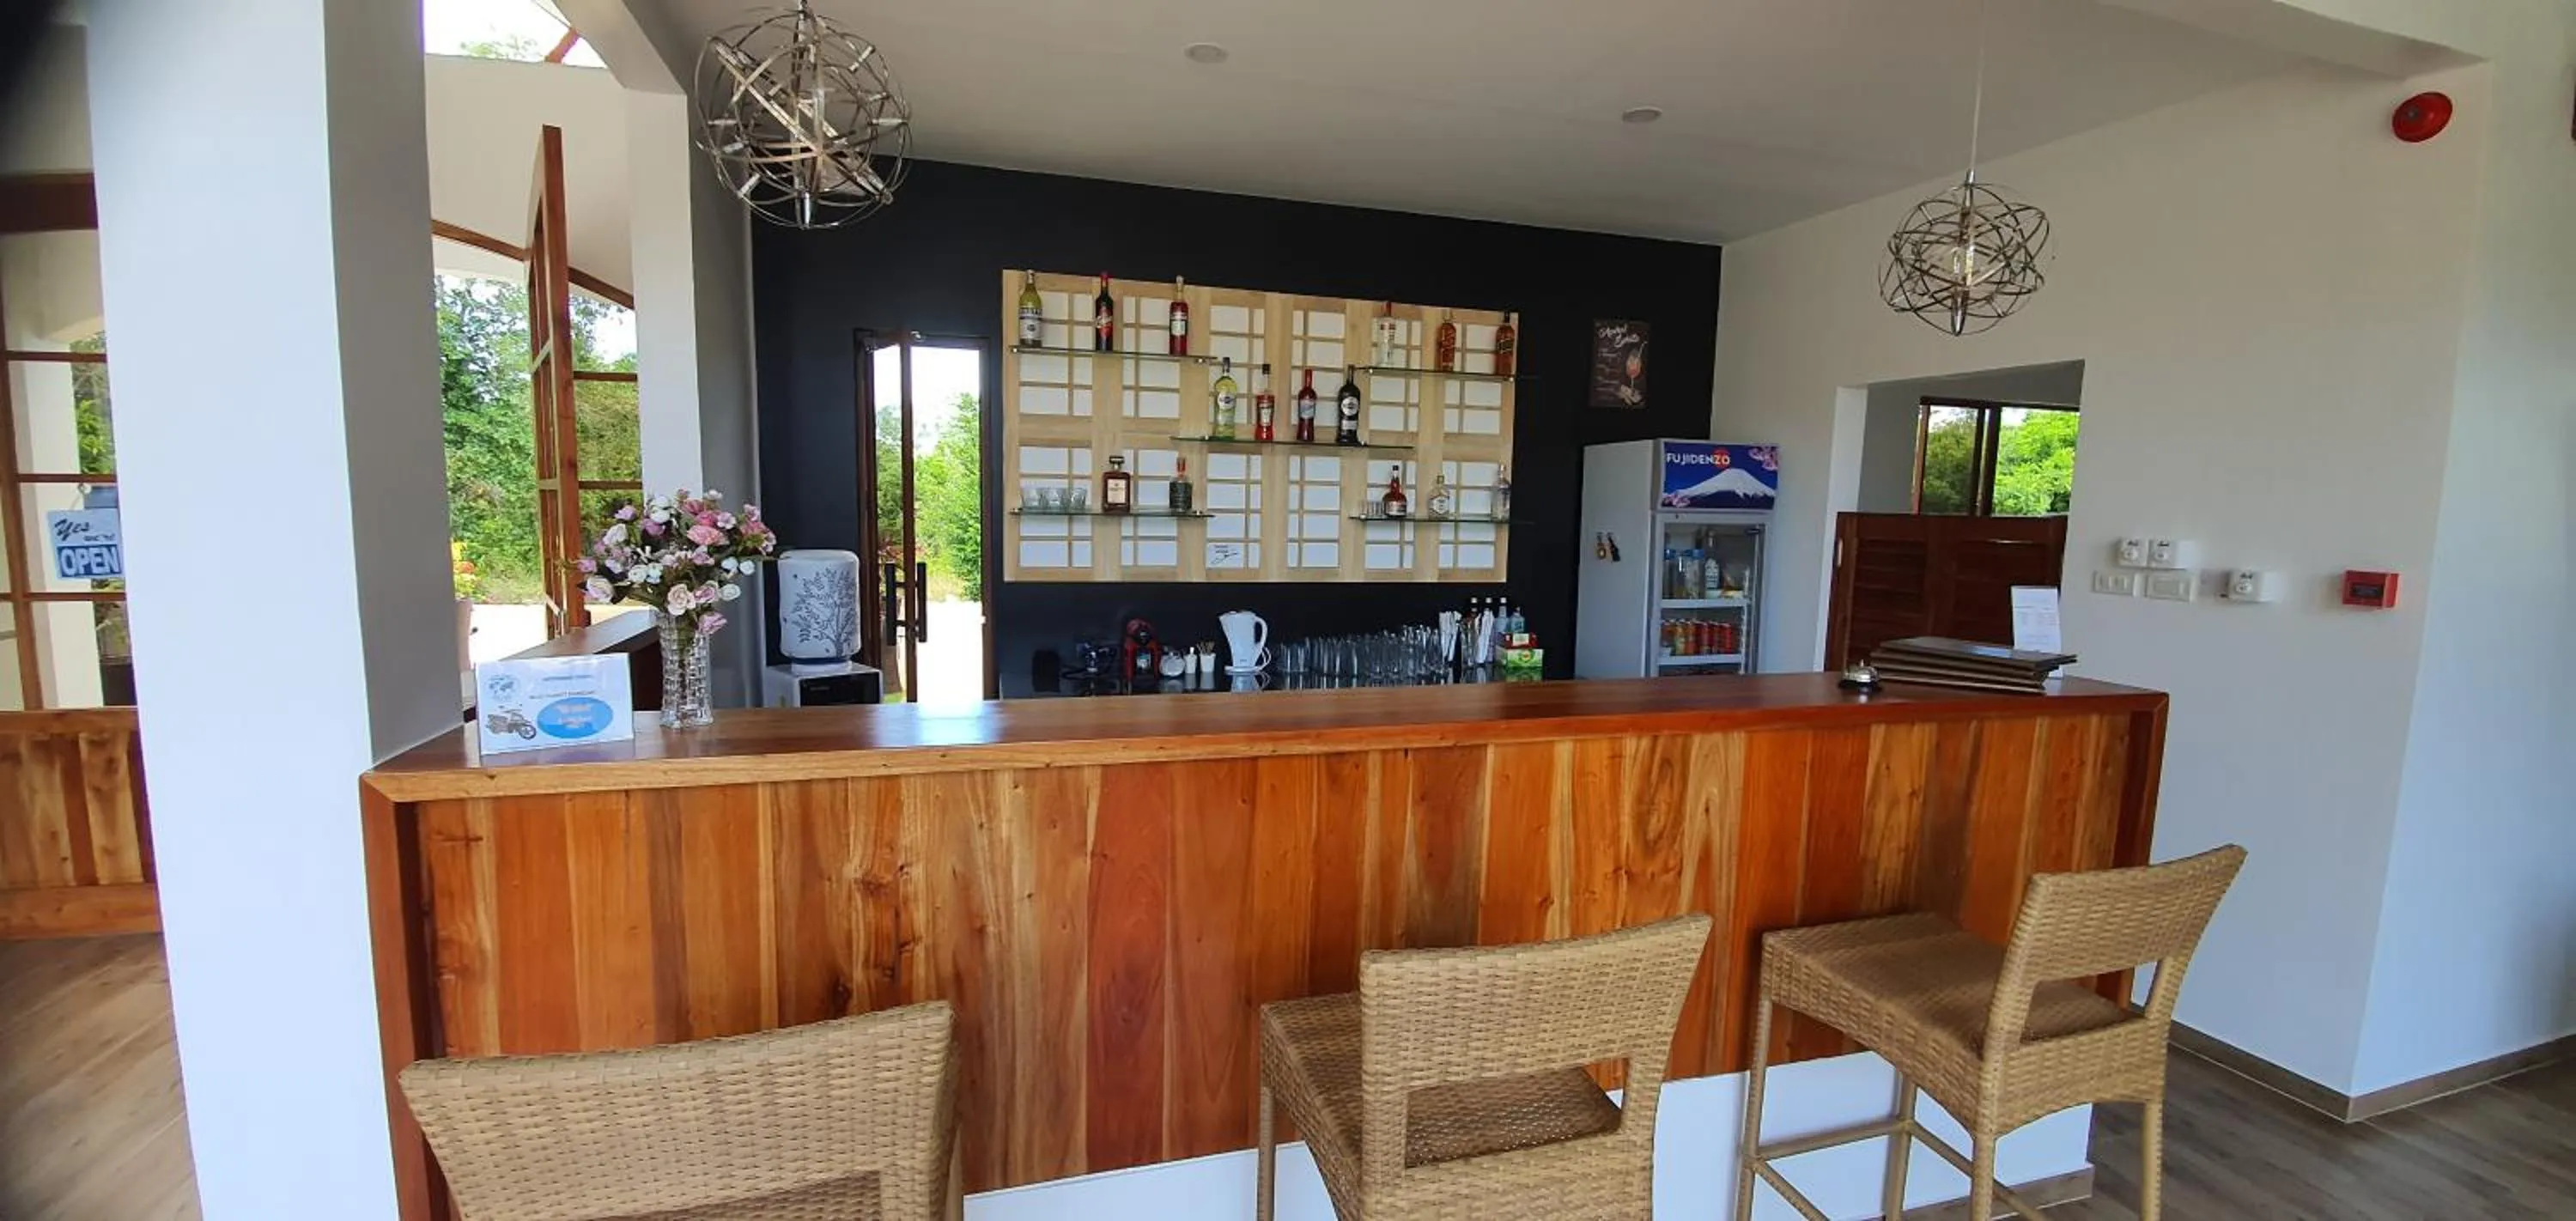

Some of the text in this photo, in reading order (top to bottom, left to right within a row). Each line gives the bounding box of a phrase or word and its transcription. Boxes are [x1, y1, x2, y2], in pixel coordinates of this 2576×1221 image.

[1667, 453, 1731, 465] FUJIDENZO
[54, 519, 90, 541] Yes
[61, 546, 121, 576] OPEN
